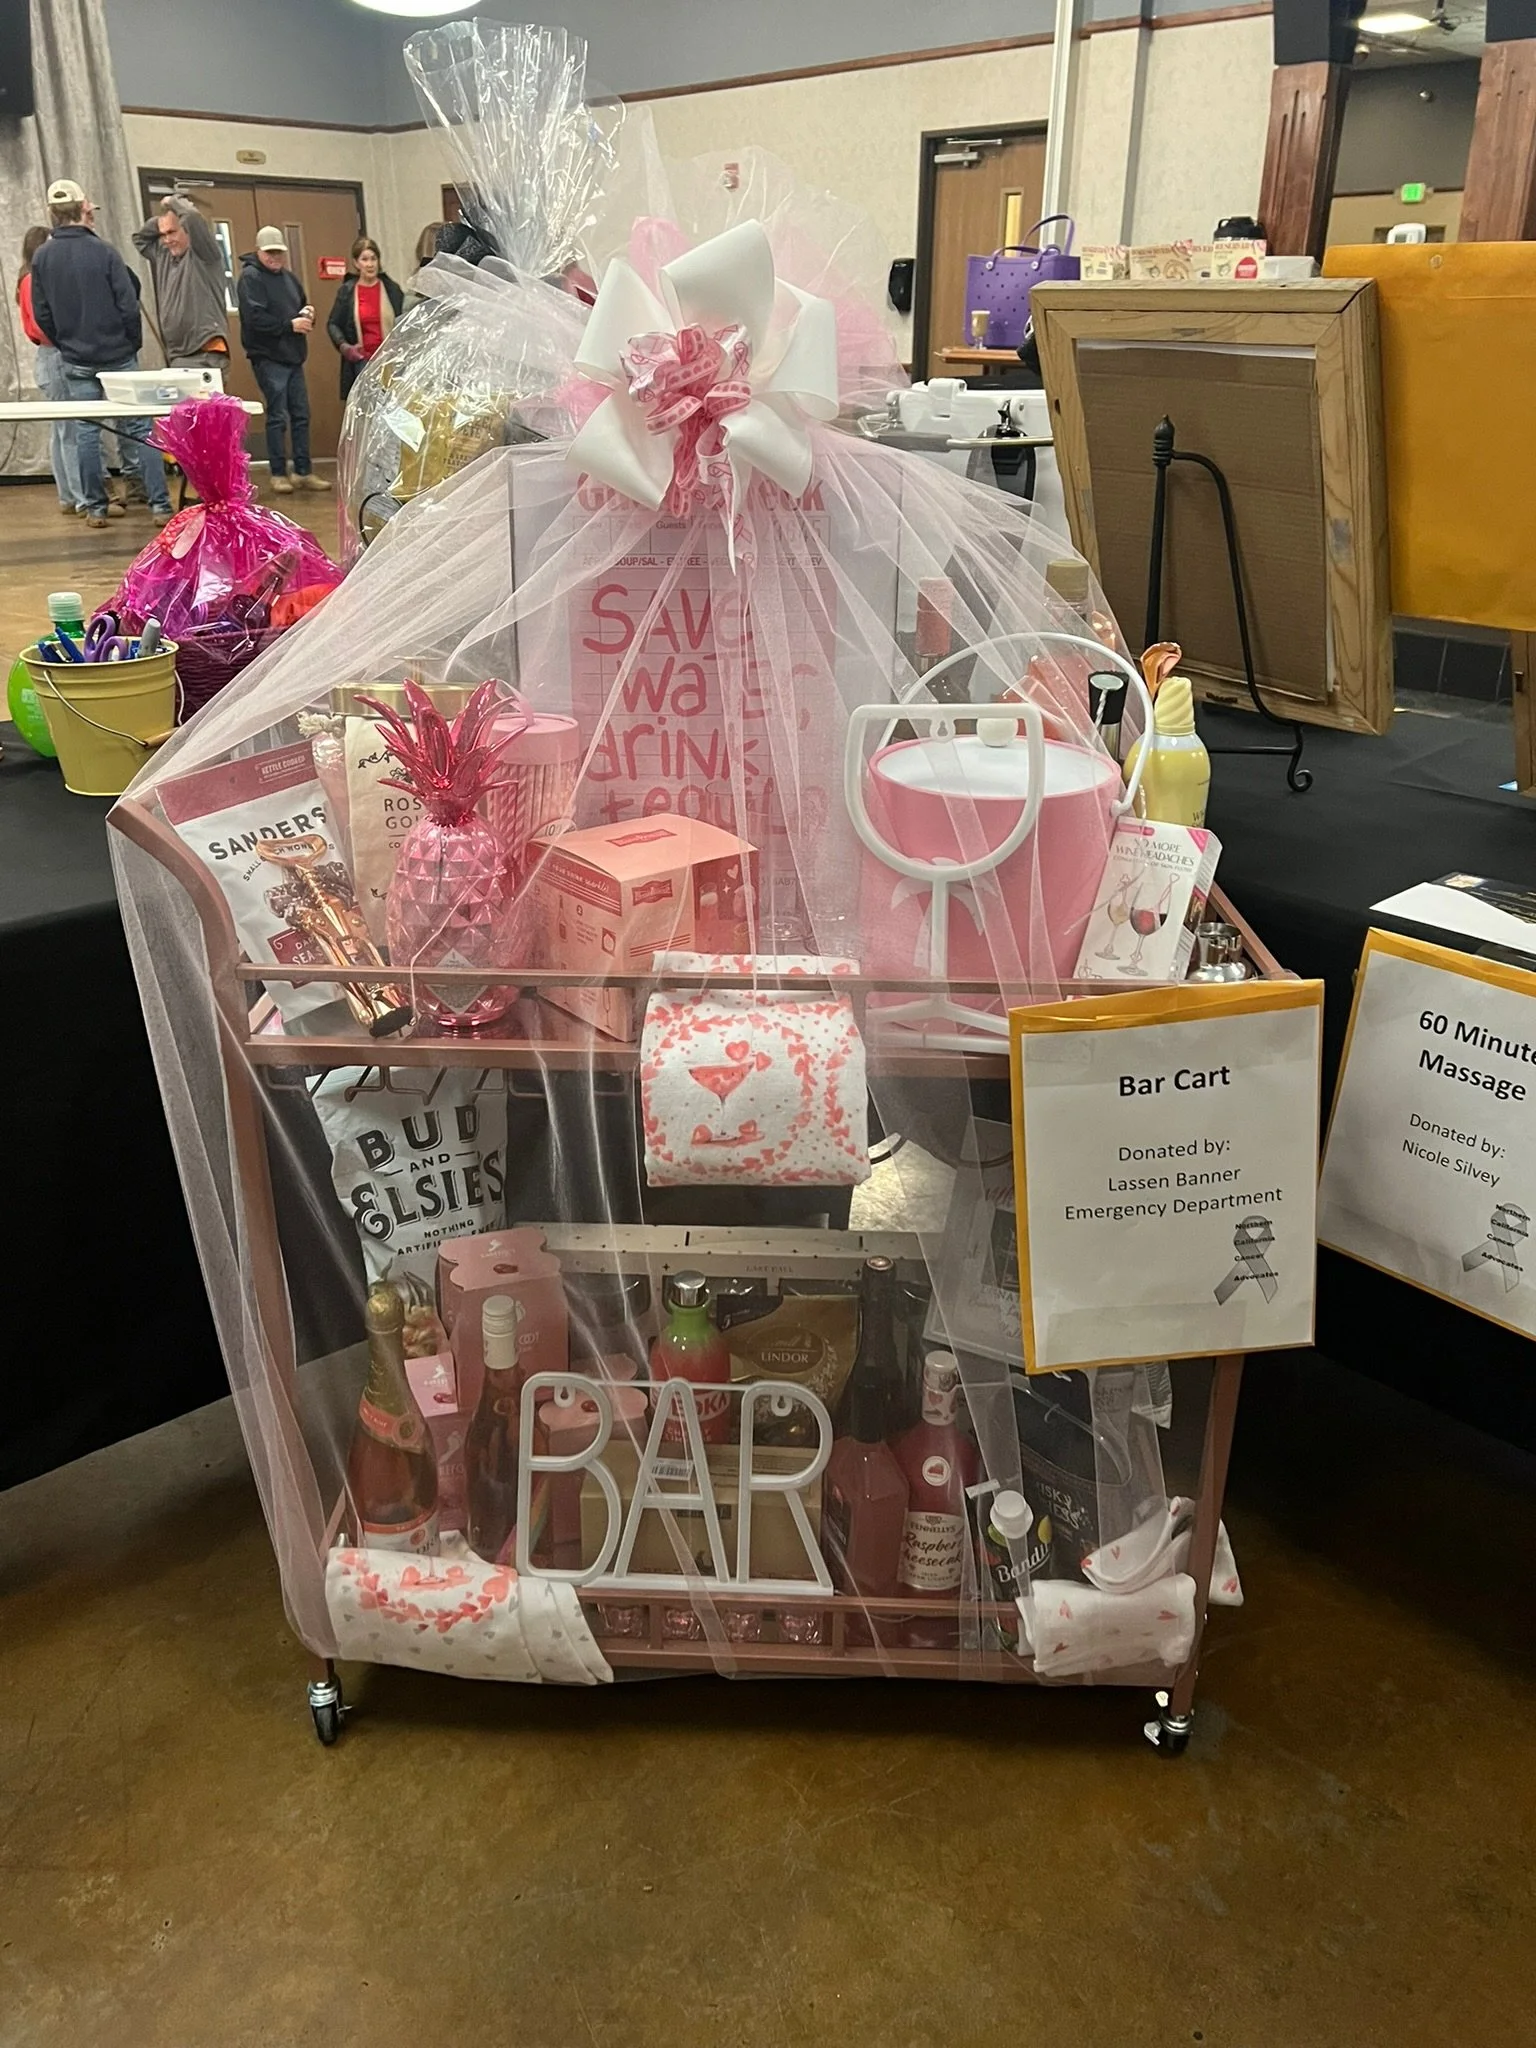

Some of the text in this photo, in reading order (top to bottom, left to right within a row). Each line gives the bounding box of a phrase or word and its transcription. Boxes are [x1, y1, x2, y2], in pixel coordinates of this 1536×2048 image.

[656, 520, 686, 529] Guests
[384, 797, 423, 812] ROS
[386, 815, 420, 829] GO
[208, 806, 326, 861] SANDERS
[1152, 841, 1182, 853] MORE
[242, 860, 263, 882] SMALL
[292, 949, 317, 966] SEA
[1419, 1010, 1449, 1035] 60
[1119, 1065, 1231, 1097] Bar Cart
[1418, 1049, 1527, 1101] Massage
[356, 1104, 481, 1171] BUD
[1409, 1113, 1506, 1159] Donated by:
[1118, 1138, 1231, 1162] Donated by:
[409, 1153, 450, 1173] AND
[1402, 1139, 1501, 1188] Nicole Silvey
[1108, 1167, 1242, 1192] Lassen Banner
[351, 1151, 504, 1242] ELSIES
[1065, 1188, 1283, 1221] Emergency Department
[1495, 1203, 1531, 1222] Northern
[423, 1219, 475, 1239] NOTHING
[1235, 1220, 1273, 1230] Northern
[1490, 1218, 1529, 1238] California
[1233, 1236, 1276, 1246] California
[1486, 1233, 1515, 1247] Cancer
[1234, 1253, 1264, 1262] Cancer
[1481, 1251, 1524, 1272] Advocates
[1233, 1271, 1279, 1281] Advocates
[761, 1351, 809, 1364] LINDOR
[514, 1371, 834, 1589] BAR
[904, 1530, 962, 1554] Raspber
